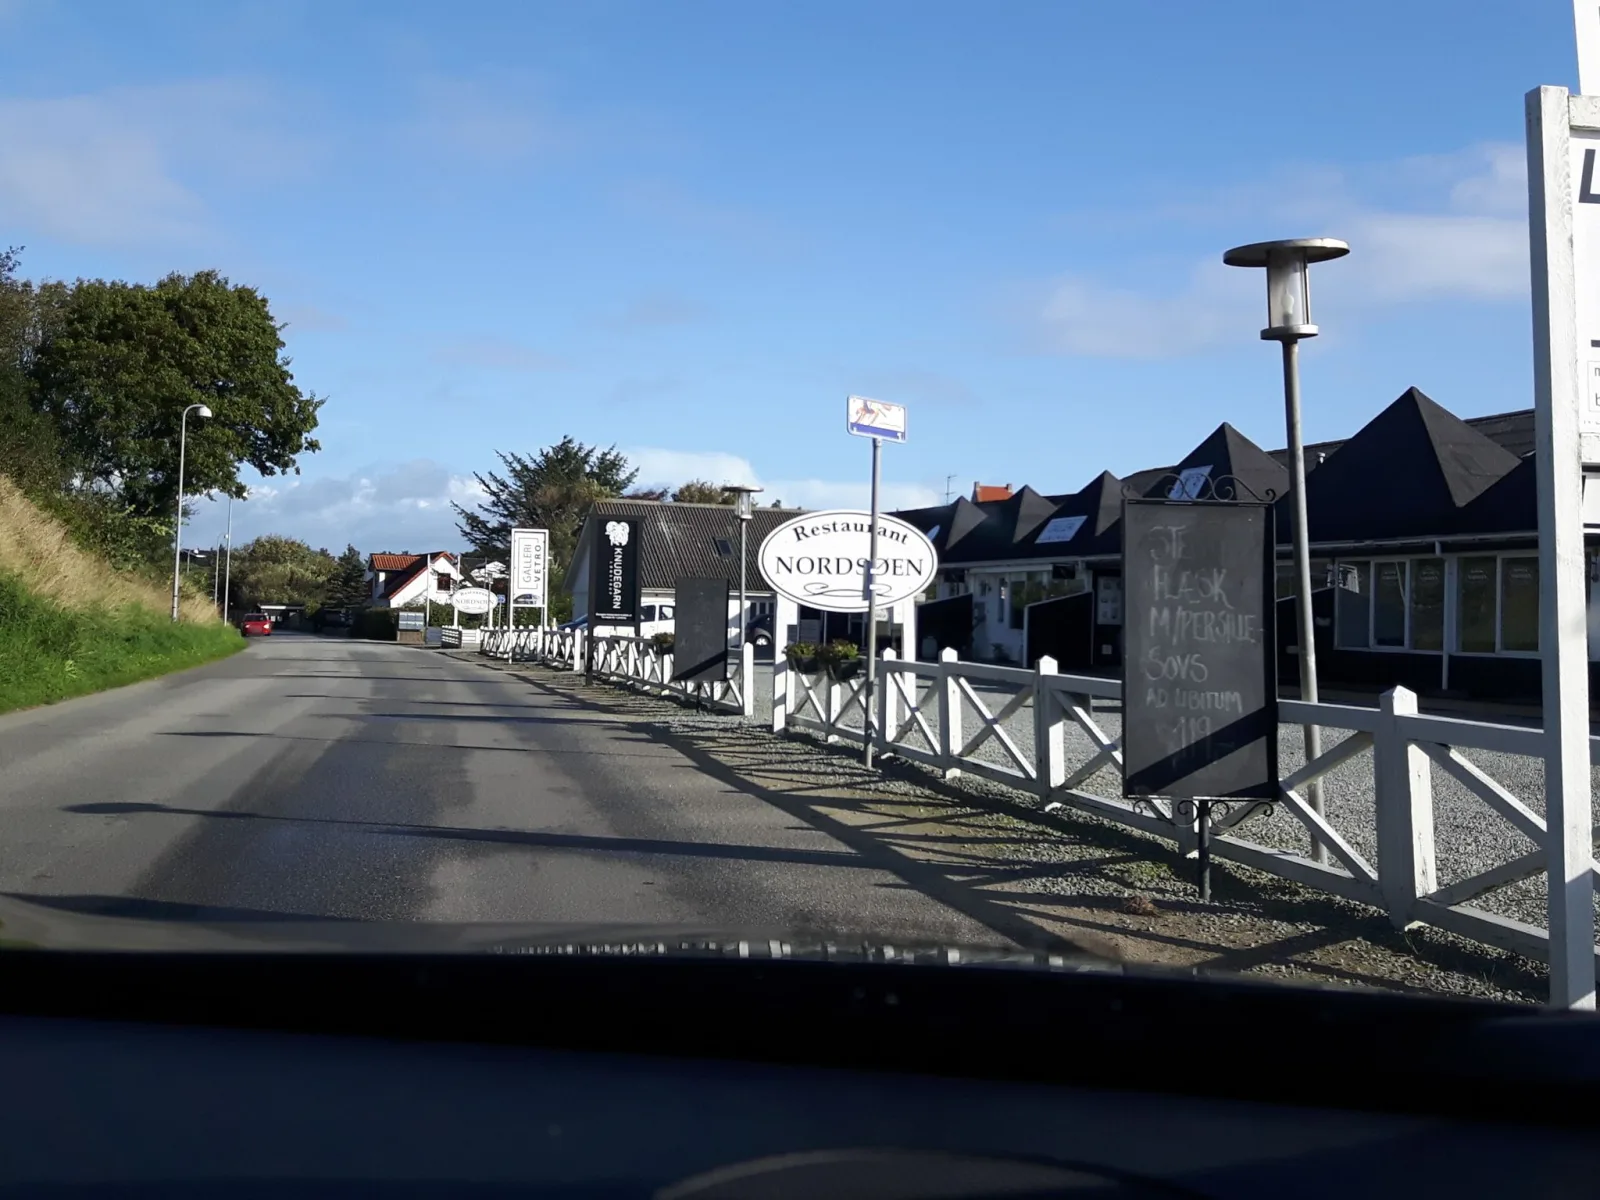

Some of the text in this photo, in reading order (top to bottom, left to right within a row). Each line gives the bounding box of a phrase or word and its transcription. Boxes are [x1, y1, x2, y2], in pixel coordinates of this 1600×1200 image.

[792, 520, 908, 545] Restaurant
[523, 544, 532, 583] GALLERI
[534, 544, 542, 583] VETRO
[612, 547, 623, 609] KNUDEGARN
[775, 556, 923, 576] NORDSØEN
[1145, 646, 1208, 683] SOVS
